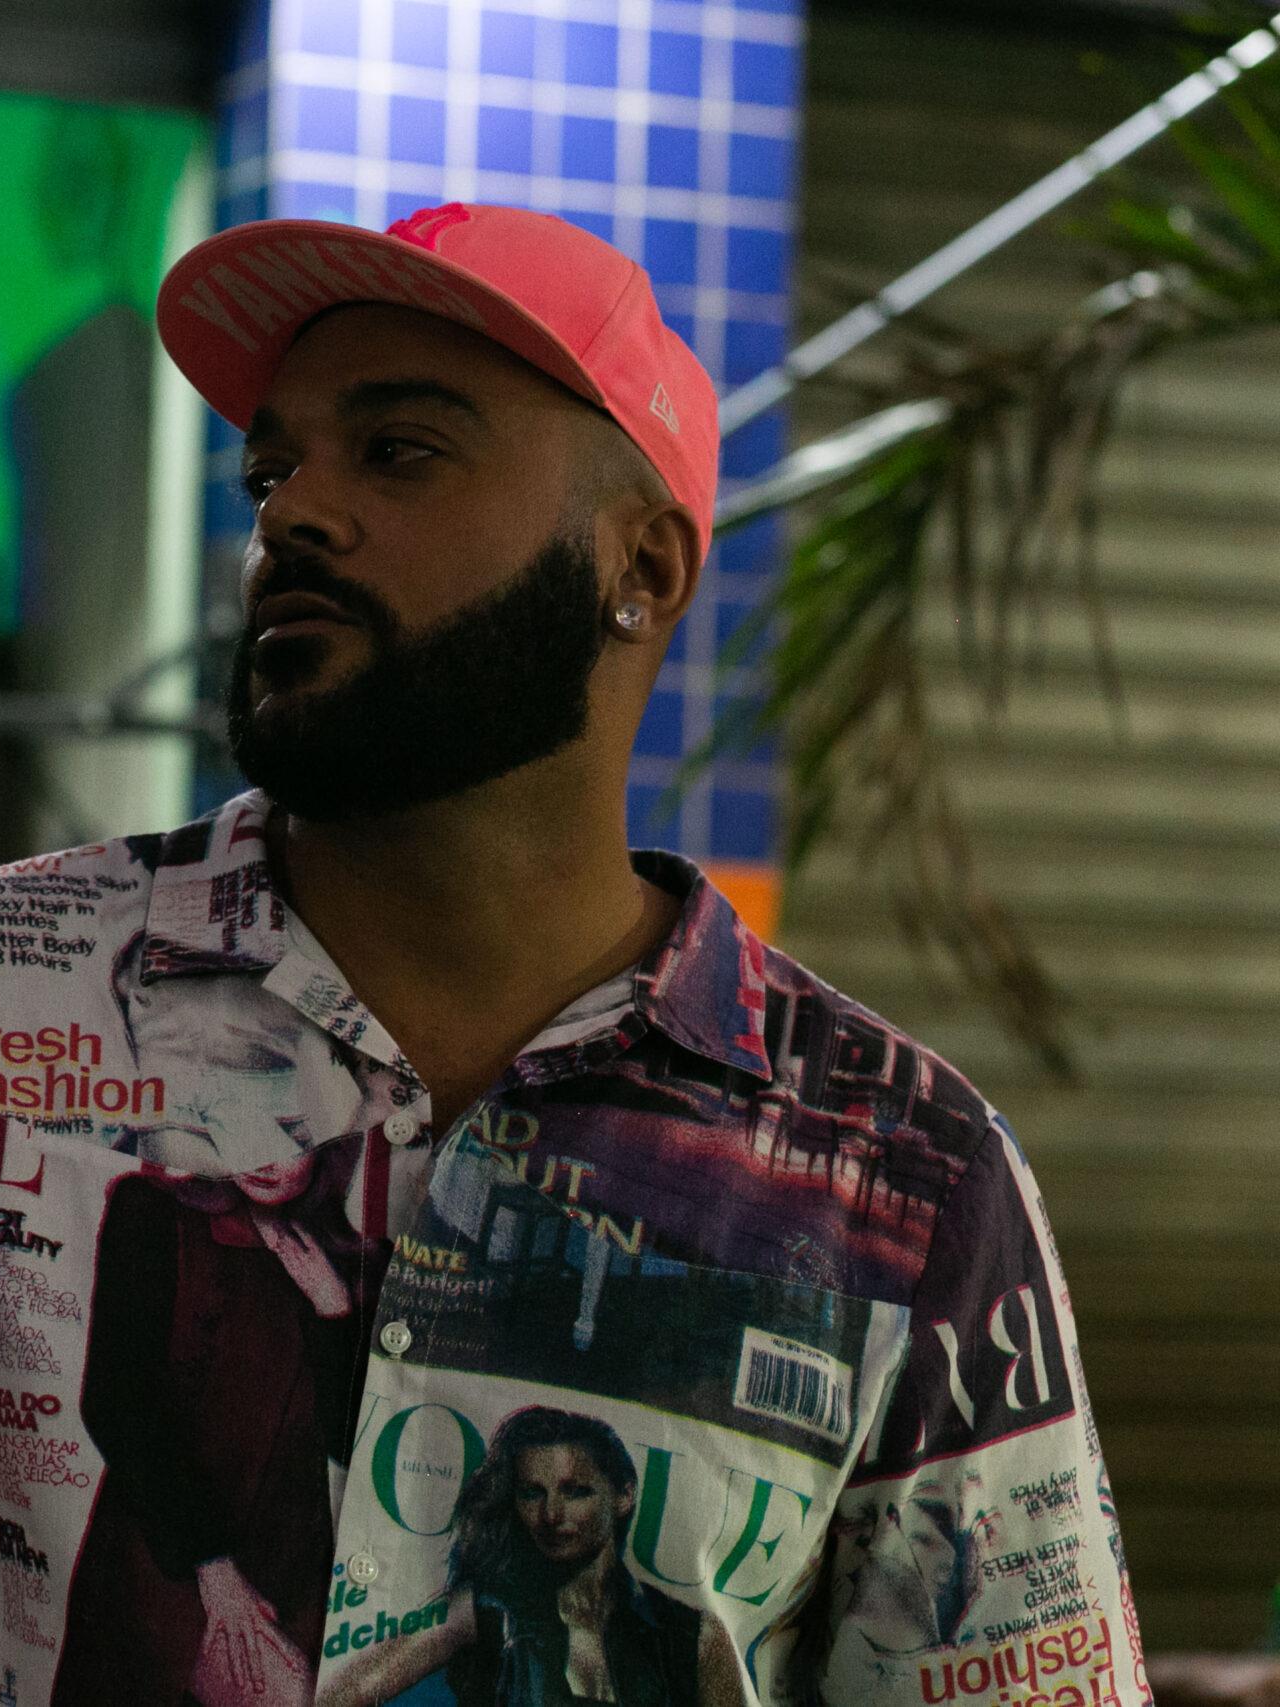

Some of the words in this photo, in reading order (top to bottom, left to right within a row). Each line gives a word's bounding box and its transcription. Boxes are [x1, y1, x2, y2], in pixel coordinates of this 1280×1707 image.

[177, 238, 487, 354] YANKEES
[11, 883, 103, 900] Seconds
[28, 896, 72, 916] Hair
[42, 932, 97, 958] Body
[10, 949, 73, 973] Hours
[33, 1115, 95, 1135] PRINTS
[20, 1391, 63, 1416] DO
[23, 1465, 91, 1489] SELEÇÃO
[981, 1549, 1035, 1578] HEELS
[1040, 1594, 1090, 1625] POWER
[983, 1614, 1038, 1644] PRINTS
[919, 1617, 1113, 1704] Fashion
